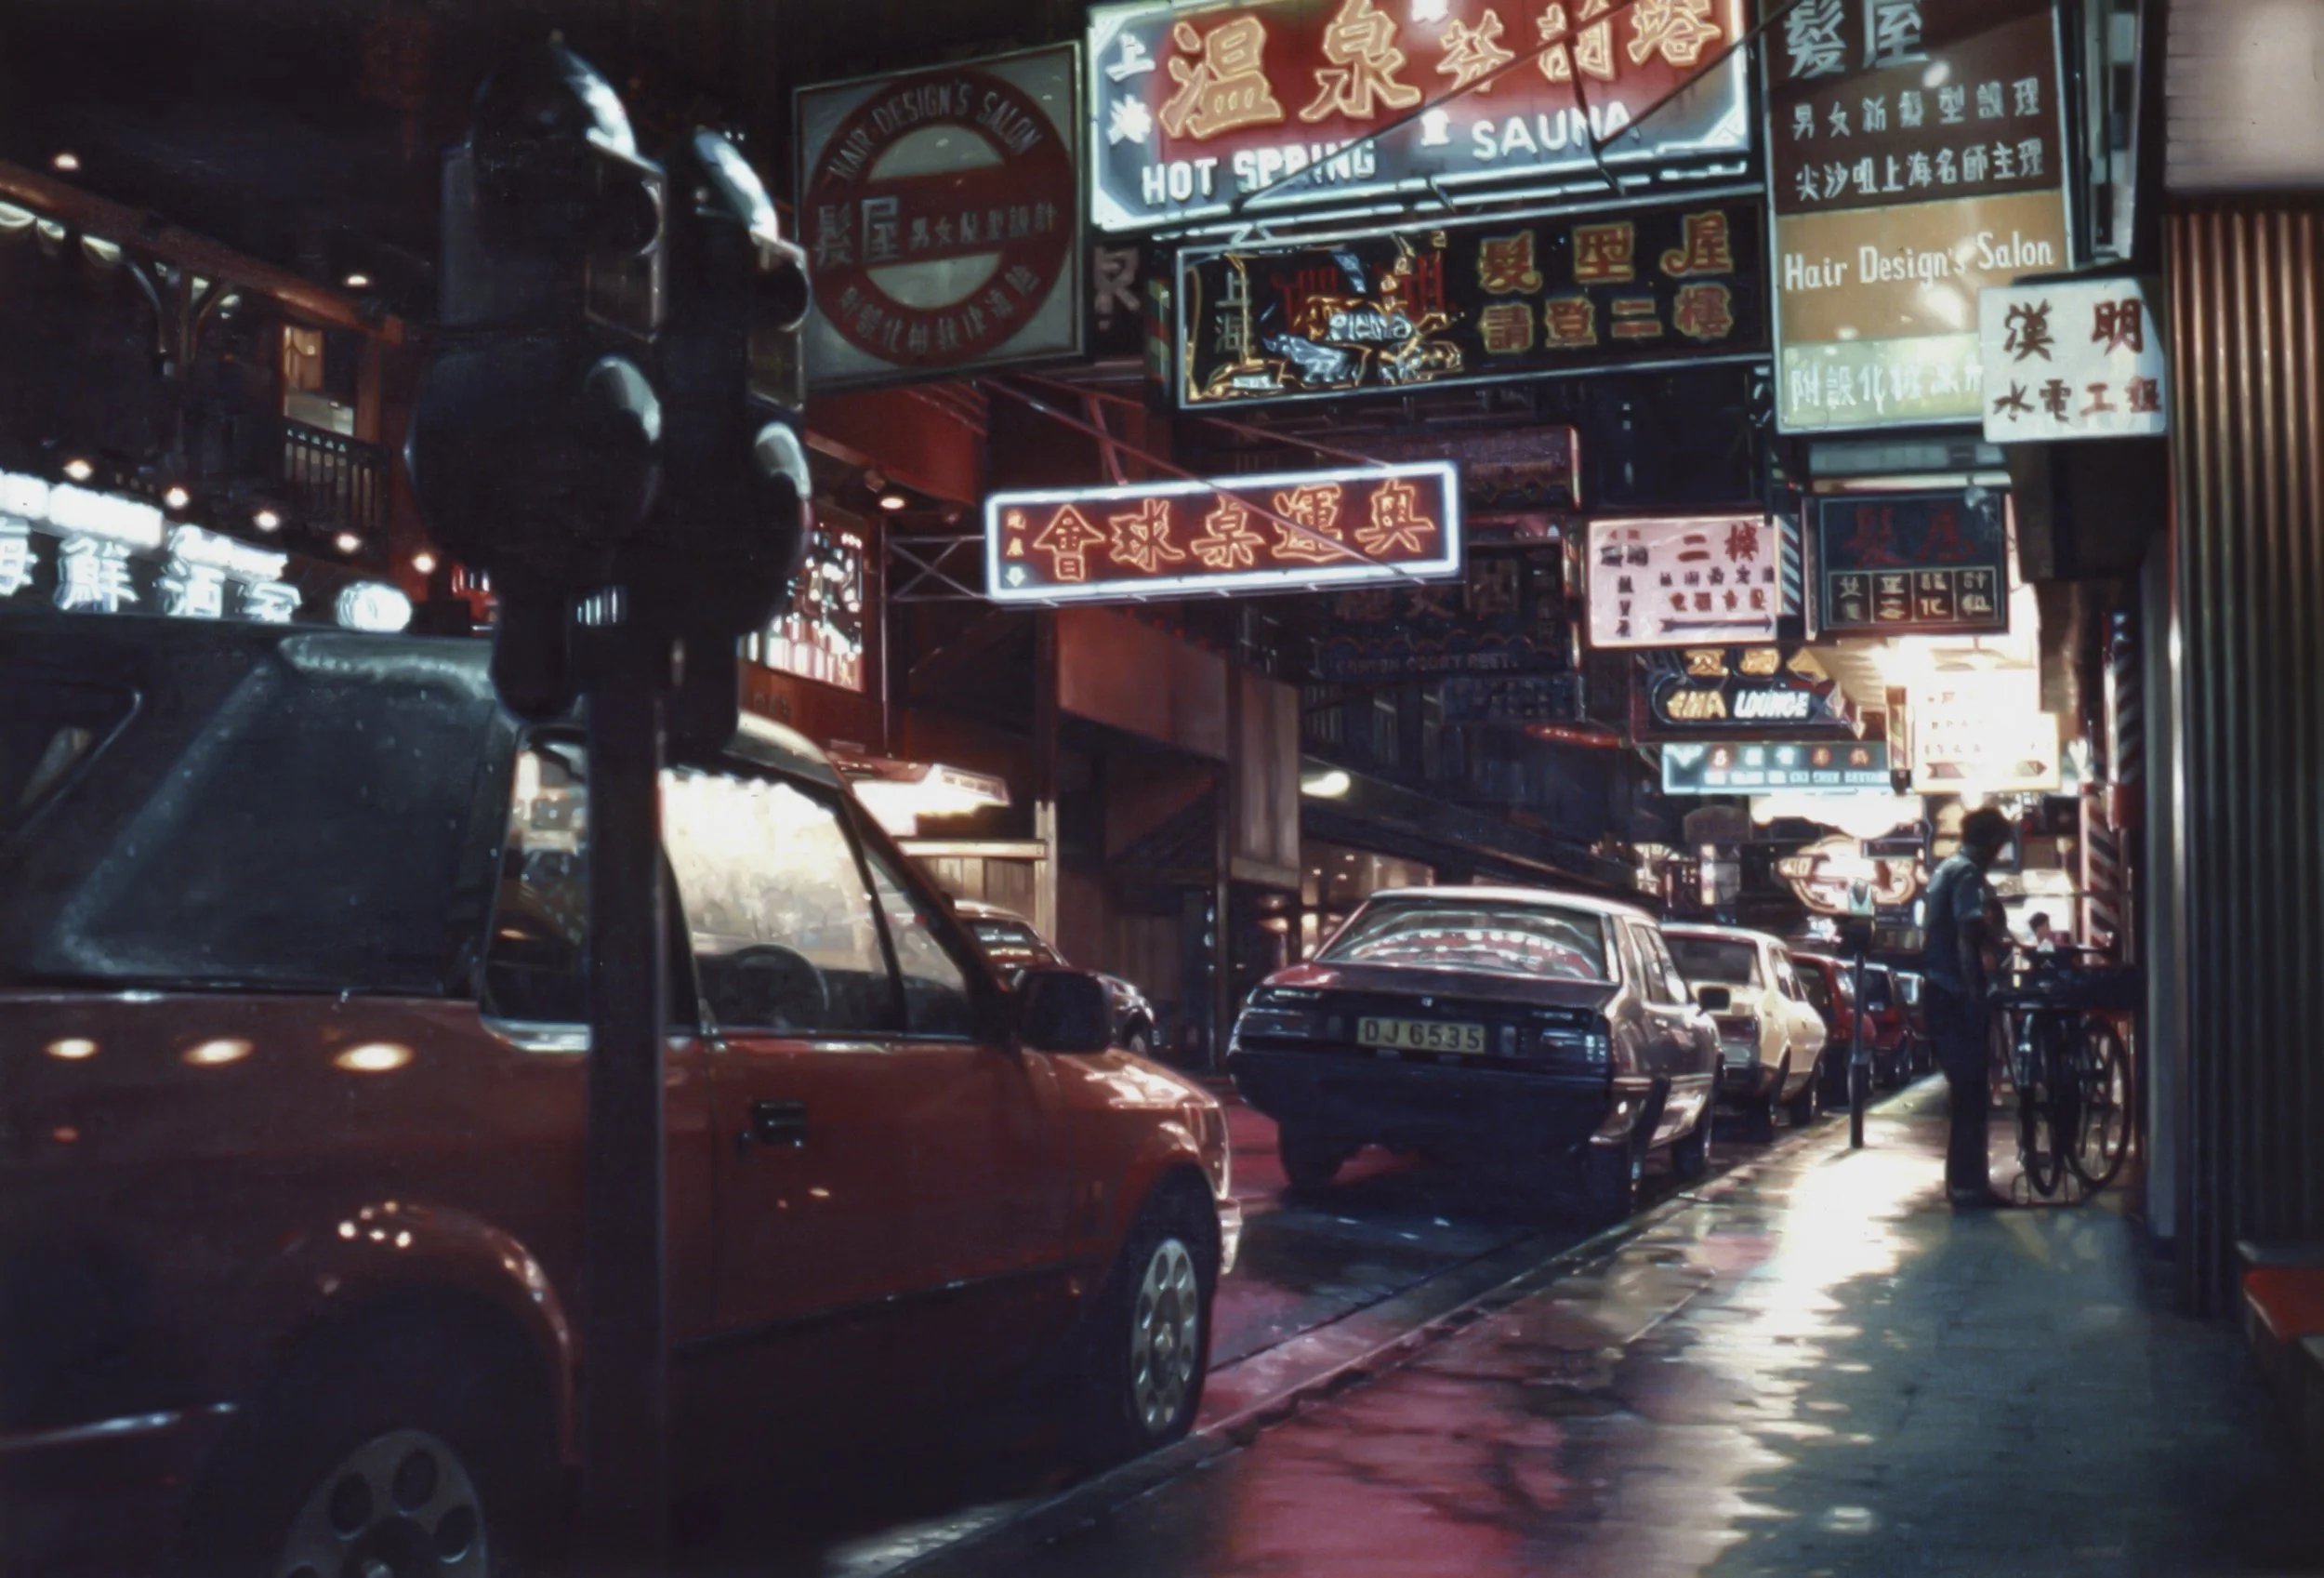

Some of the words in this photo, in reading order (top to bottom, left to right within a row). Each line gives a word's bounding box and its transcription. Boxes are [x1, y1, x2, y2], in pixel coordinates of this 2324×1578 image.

[827, 125, 876, 181] HAIR
[976, 90, 1043, 154] SALON
[1142, 157, 1217, 206] HOT
[1233, 139, 1377, 192] SPRING
[1472, 101, 1640, 160] SAUNA
[1785, 252, 1847, 292] Hair
[1975, 232, 2053, 270] Salon
[1364, 1020, 1400, 1044] DJ
[1408, 1022, 1482, 1051] 6535
